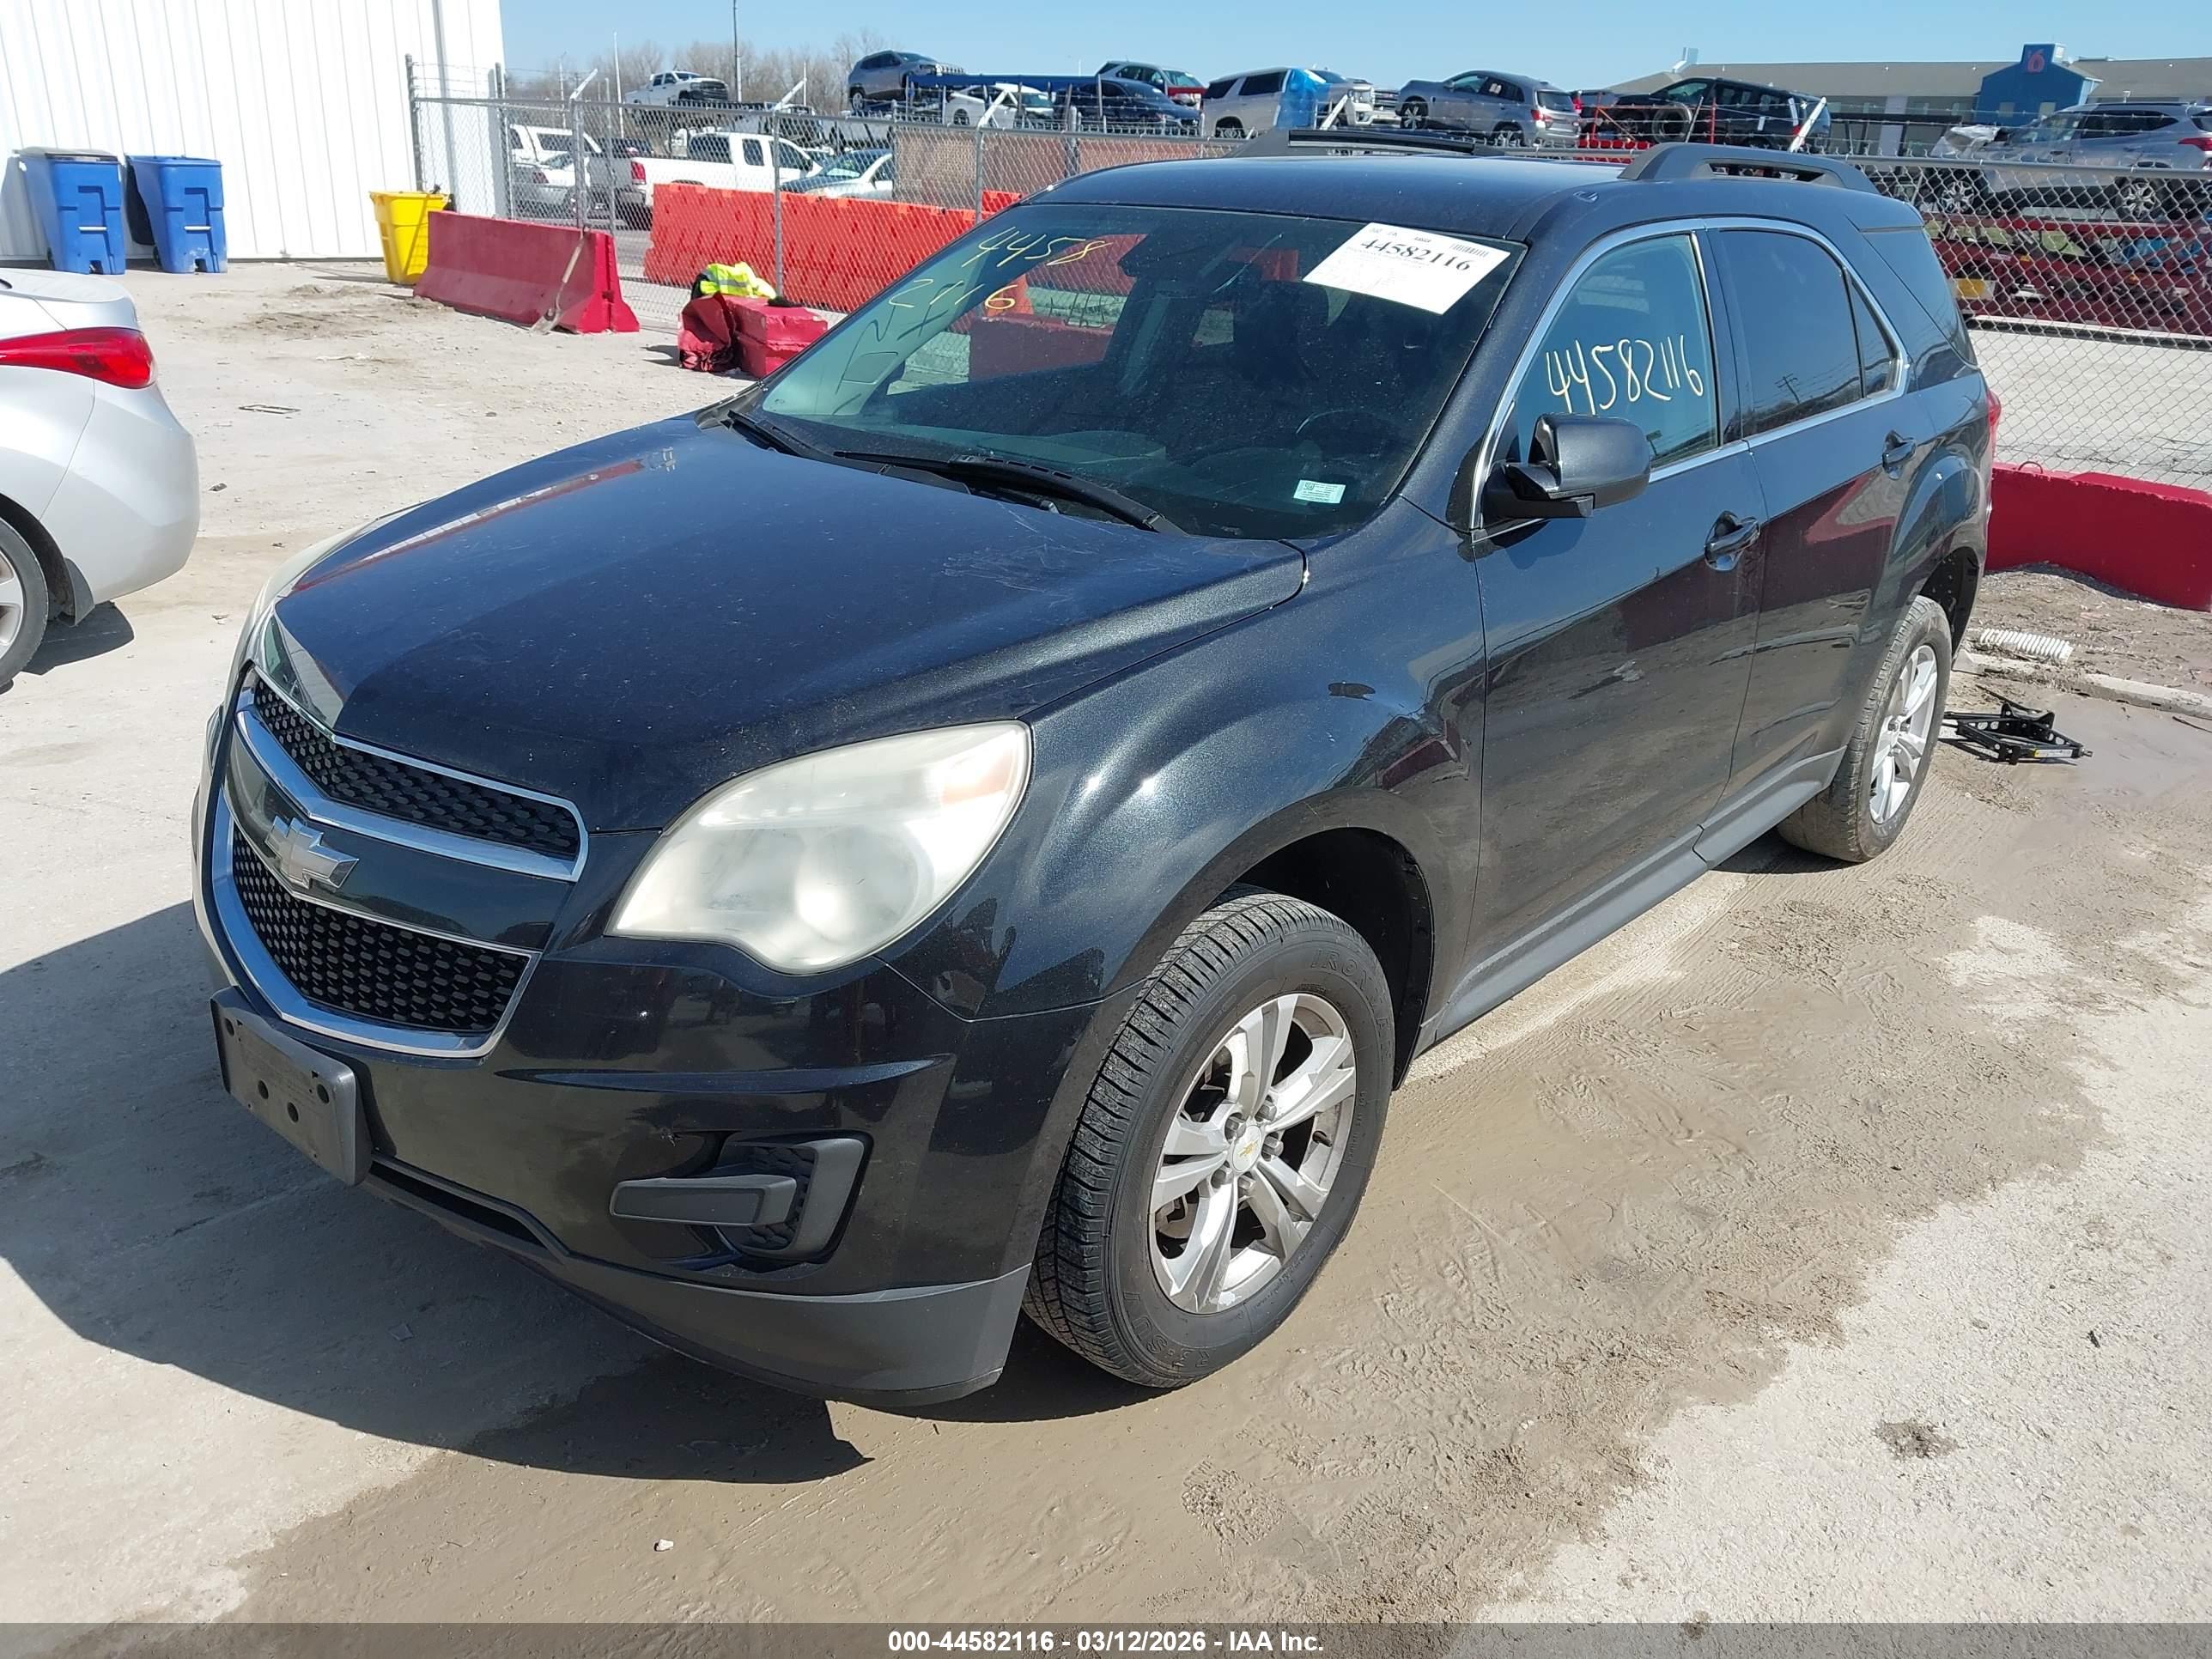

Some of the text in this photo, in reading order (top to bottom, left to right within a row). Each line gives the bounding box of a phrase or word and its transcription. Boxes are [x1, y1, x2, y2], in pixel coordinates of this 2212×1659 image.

[2026, 48, 2045, 74] 6
[961, 225, 1114, 268] 4458
[1360, 238, 1471, 272] 44582116
[888, 278, 1018, 310] 2116
[1546, 334, 1705, 416] 44582116
